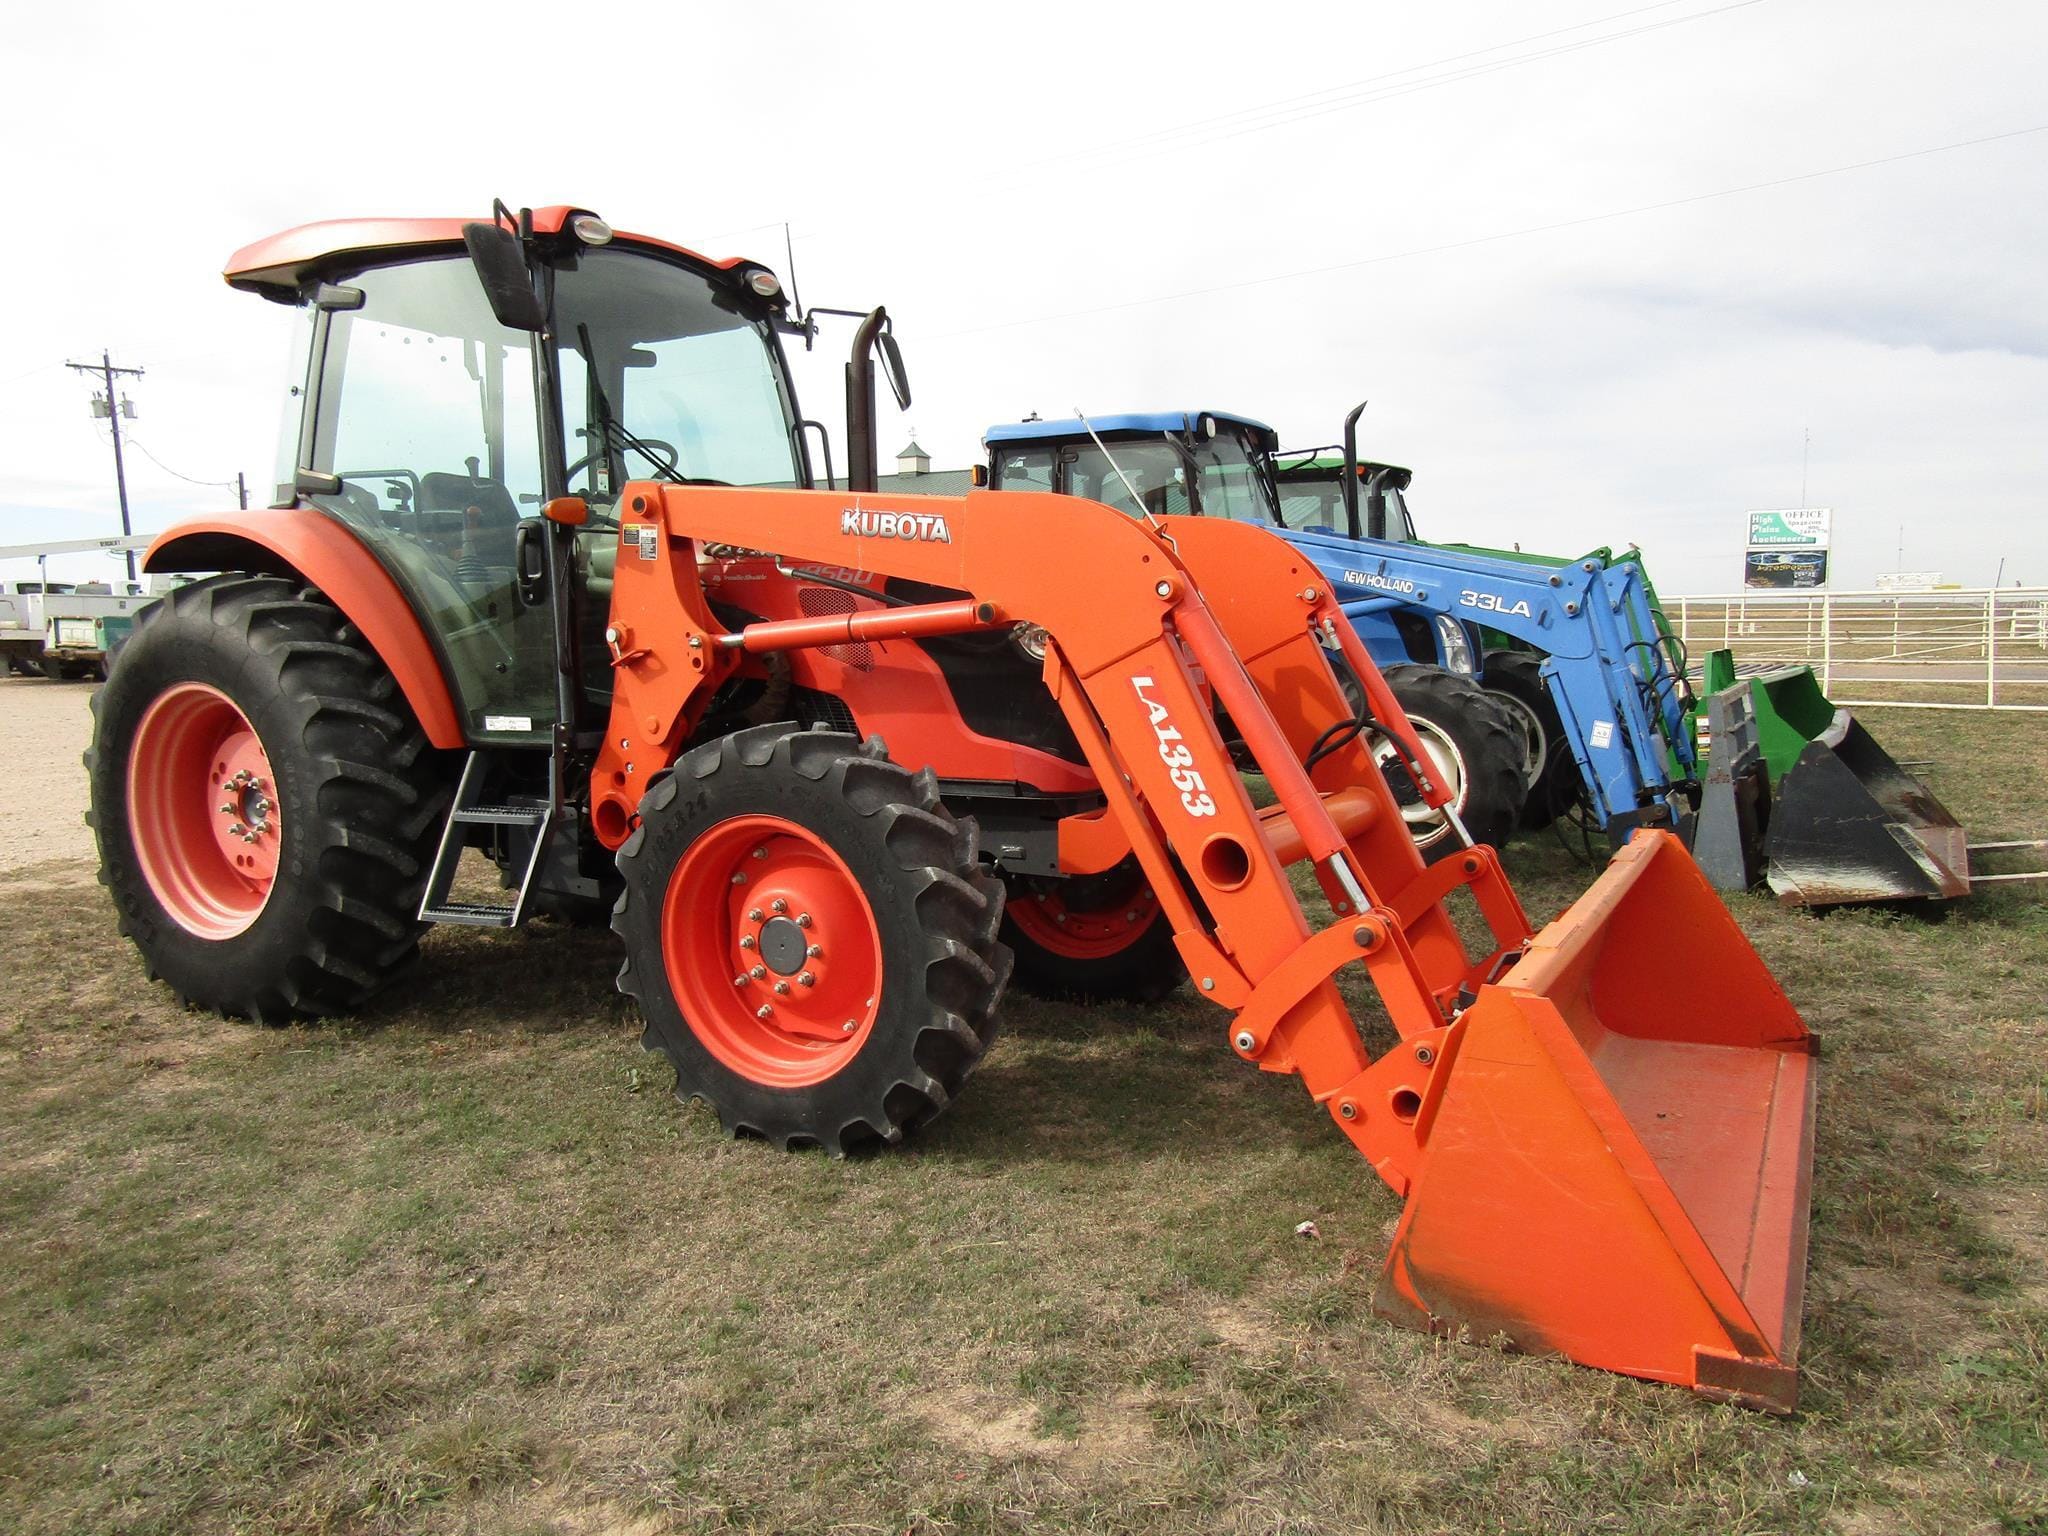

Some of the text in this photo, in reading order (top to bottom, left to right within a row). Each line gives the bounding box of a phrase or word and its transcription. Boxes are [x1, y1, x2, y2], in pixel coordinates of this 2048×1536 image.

[1752, 514, 1773, 525] High
[1785, 510, 1824, 519] OFFICE
[841, 508, 951, 544] KUBOTA
[1752, 525, 1780, 534] Plains
[1751, 534, 1807, 544] Auctioneers
[1343, 570, 1414, 594] NEW HOLLAND
[1459, 590, 1532, 618] 33LA
[1131, 676, 1217, 818] LA1353
